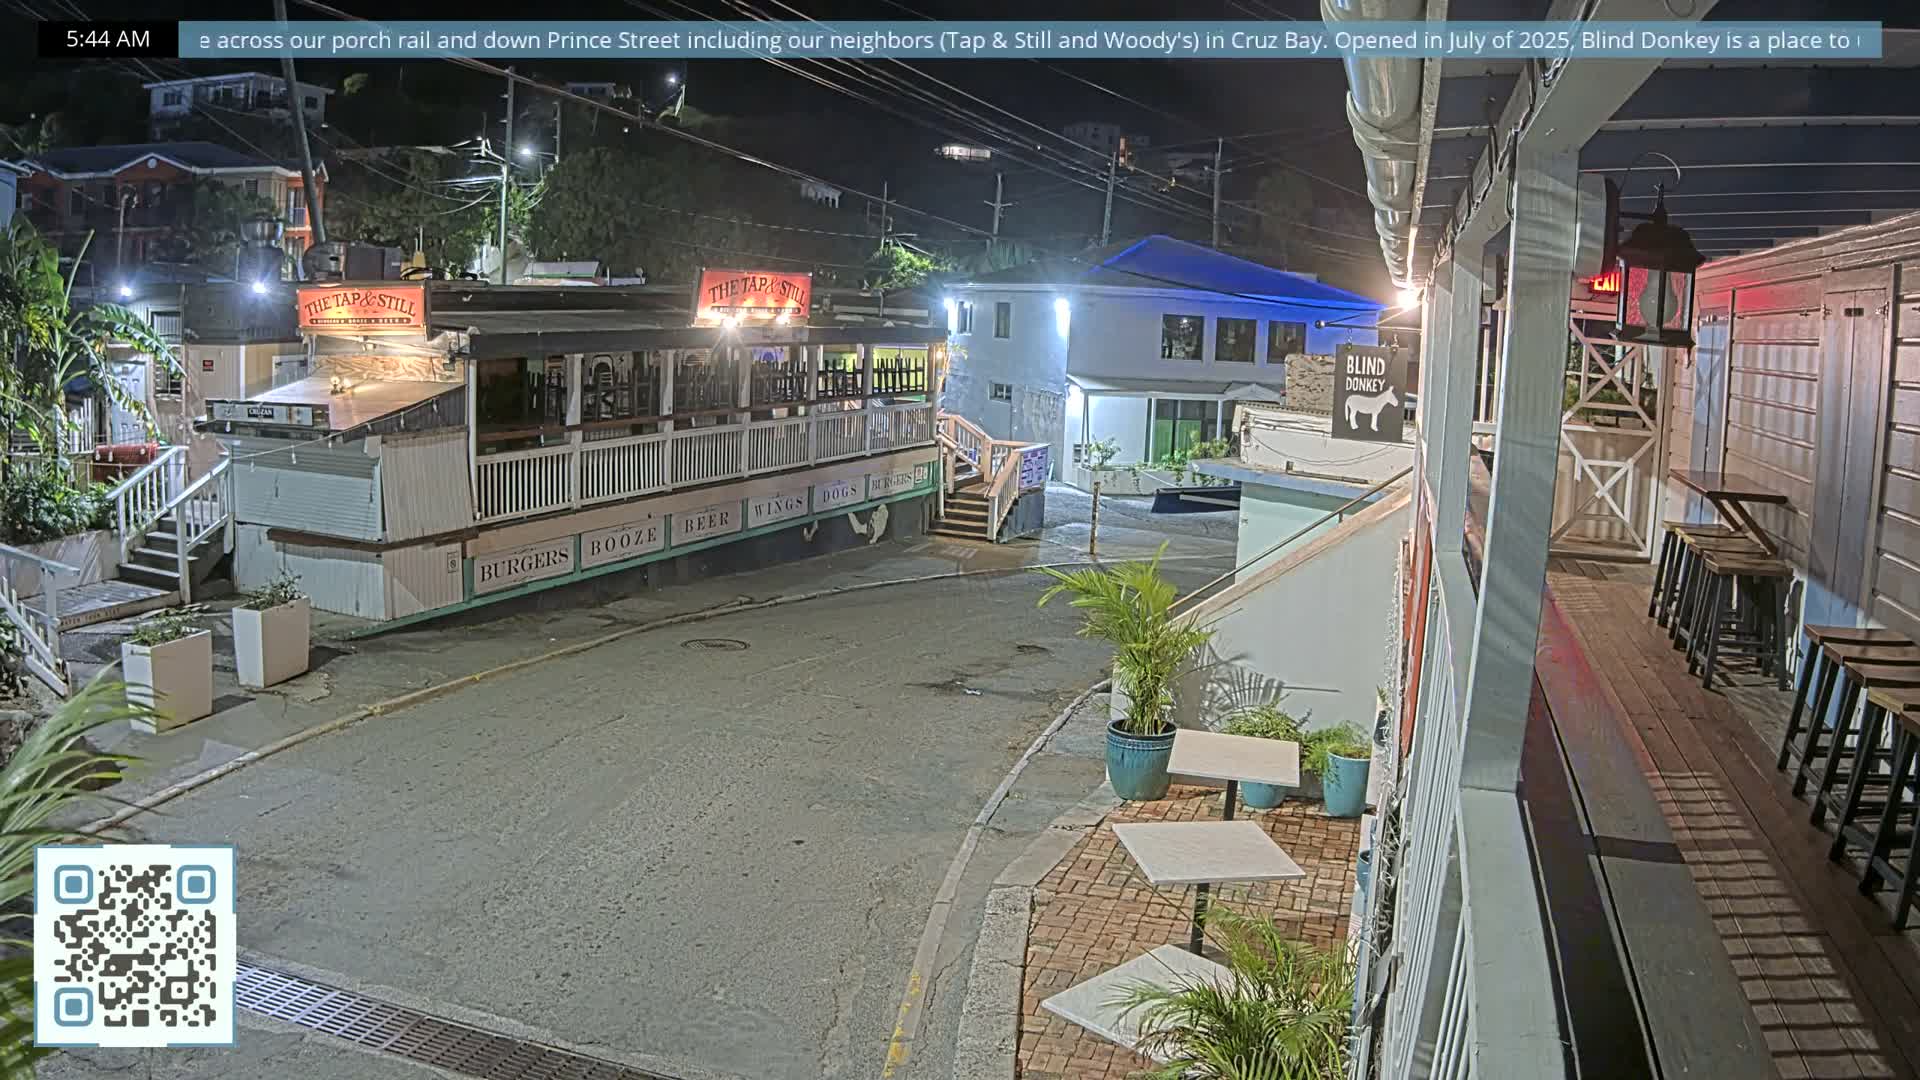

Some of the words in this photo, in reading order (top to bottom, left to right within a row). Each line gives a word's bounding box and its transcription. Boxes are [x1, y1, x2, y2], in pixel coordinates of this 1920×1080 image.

[708, 278, 739, 303] THE
[741, 276, 767, 294] TAP
[780, 280, 805, 307] STILL
[305, 296, 332, 317] THE
[332, 292, 360, 307] TAP
[360, 290, 377, 308] &
[377, 293, 416, 317] STILL
[1346, 355, 1386, 376] BLIND
[1345, 377, 1386, 392] DONKEY
[871, 471, 913, 491] BURGERS
[822, 483, 857, 503] DOGS
[753, 496, 803, 518] WINGS
[684, 510, 729, 534] BEER
[590, 526, 657, 556] BOOZE
[480, 548, 569, 583] BURGERS
